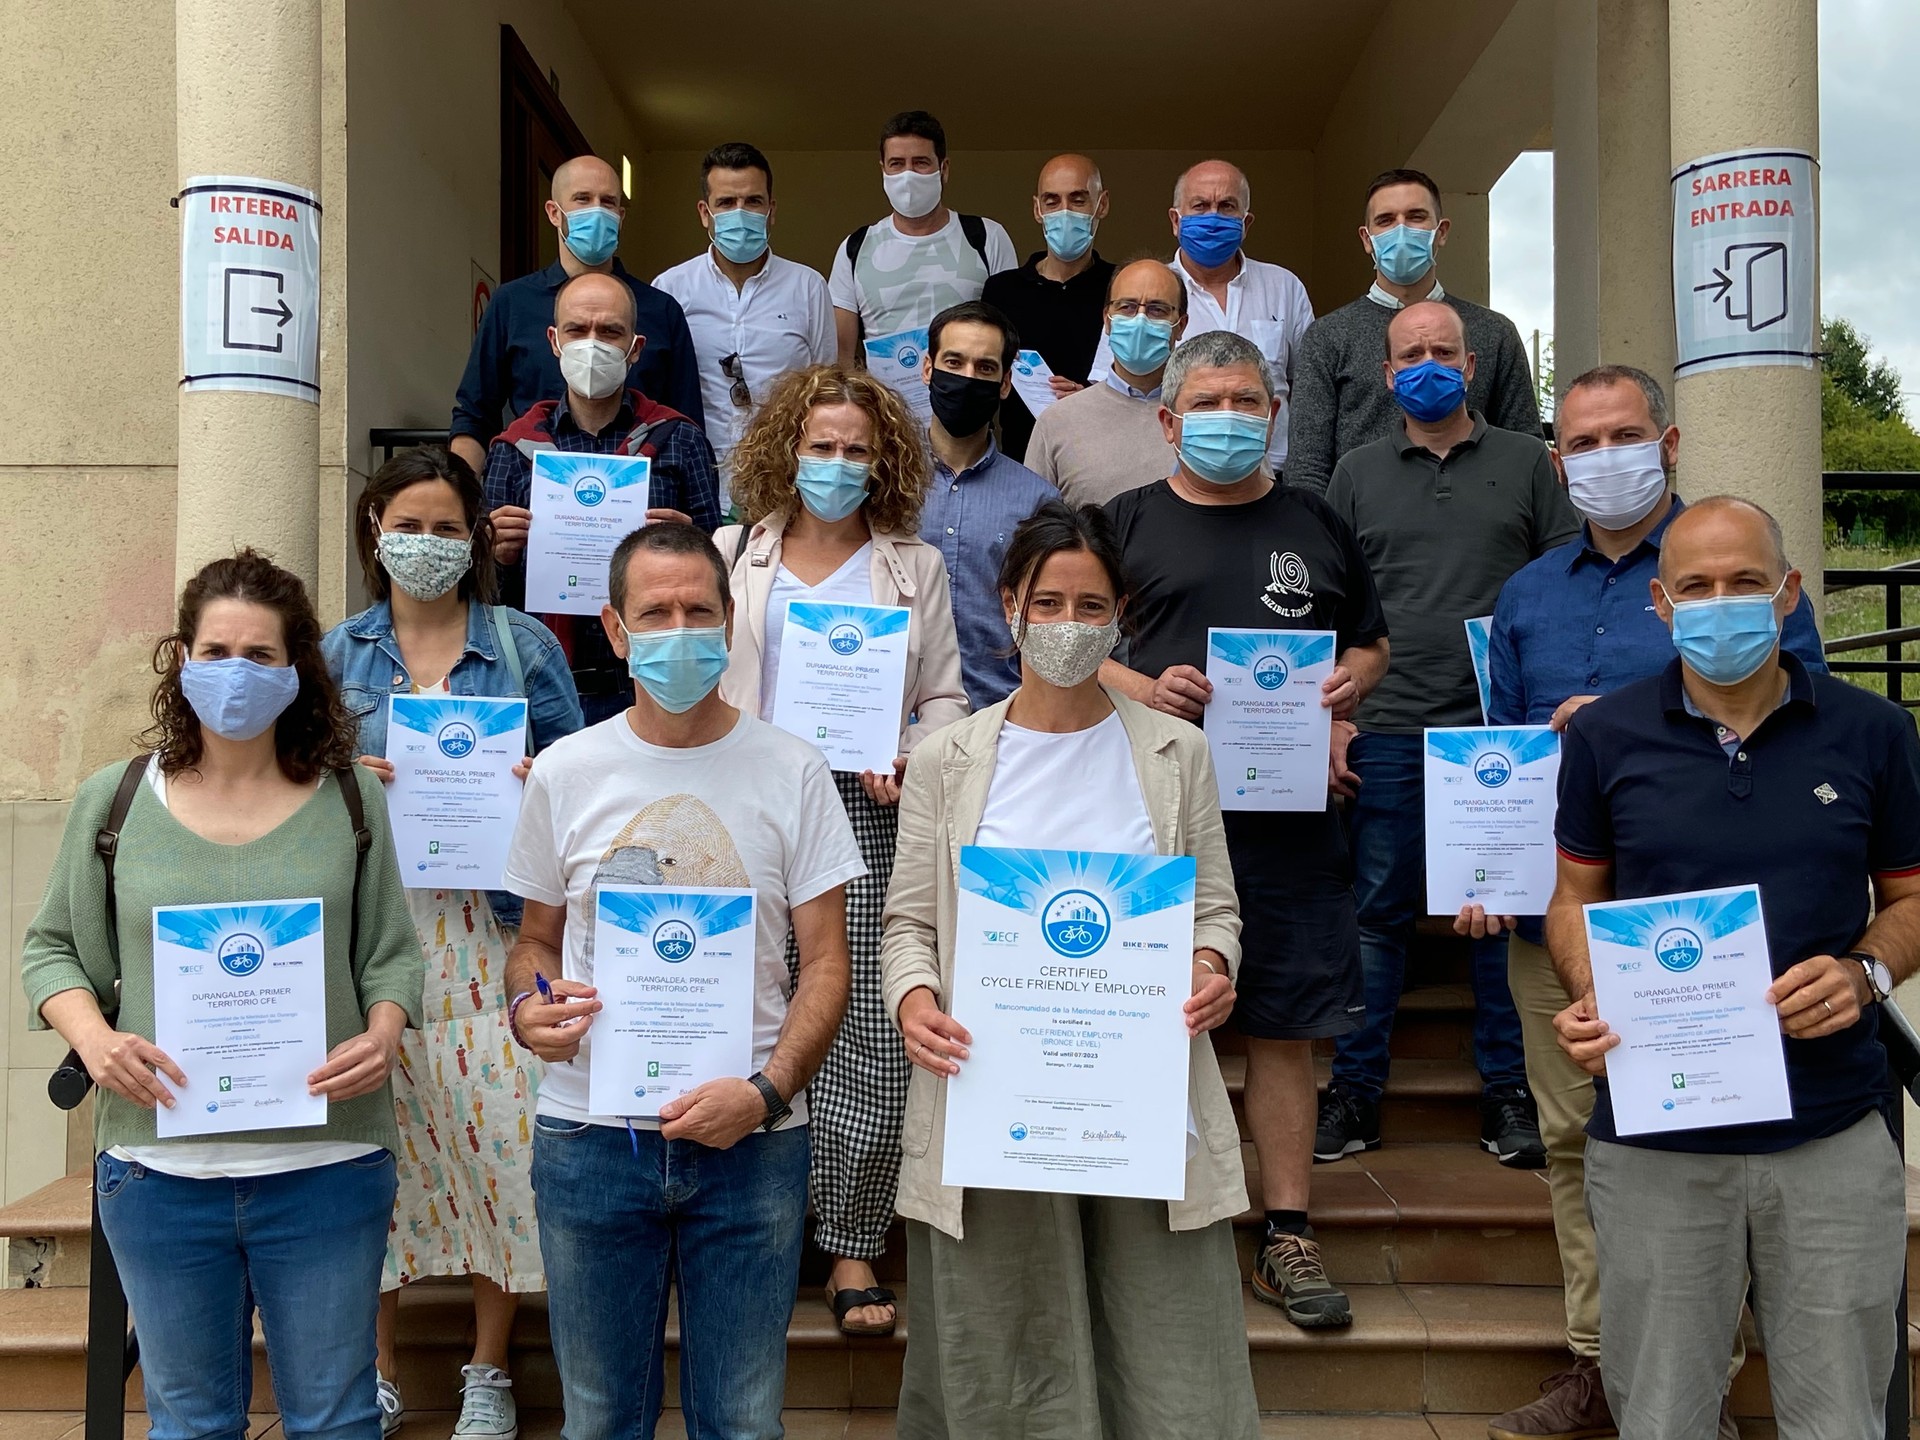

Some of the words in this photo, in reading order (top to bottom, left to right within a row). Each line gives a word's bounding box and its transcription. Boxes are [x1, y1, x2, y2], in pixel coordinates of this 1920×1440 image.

[1692, 168, 1792, 197] SARRERA
[210, 196, 299, 223] IRTEERA
[1690, 199, 1794, 228] ENTRADA
[214, 226, 295, 252] SALIDA
[998, 931, 1019, 942] ECF
[1039, 965, 1107, 979] CERTIFIED
[259, 987, 290, 996] PRIMER
[640, 984, 688, 992] TERRITORIO
[980, 976, 1023, 988] CYCLE
[1027, 978, 1089, 992] FRIENDLY
[1095, 982, 1166, 996] EMPLOYER
[1702, 980, 1736, 991] PRIMER
[207, 997, 258, 1008] TERRITORIO
[259, 996, 275, 1004] CFE
[1650, 992, 1703, 1006] TERRITORIO
[1703, 990, 1721, 1000] CFE
[994, 1002, 1050, 1012] Mancomunidad
[1071, 1007, 1105, 1015] Merindad
[1118, 1009, 1150, 1018] Durango
[1019, 1027, 1044, 1035] CYCLE
[1044, 1028, 1081, 1037] FRIENDLY
[1081, 1031, 1122, 1040] EMPLOYER
